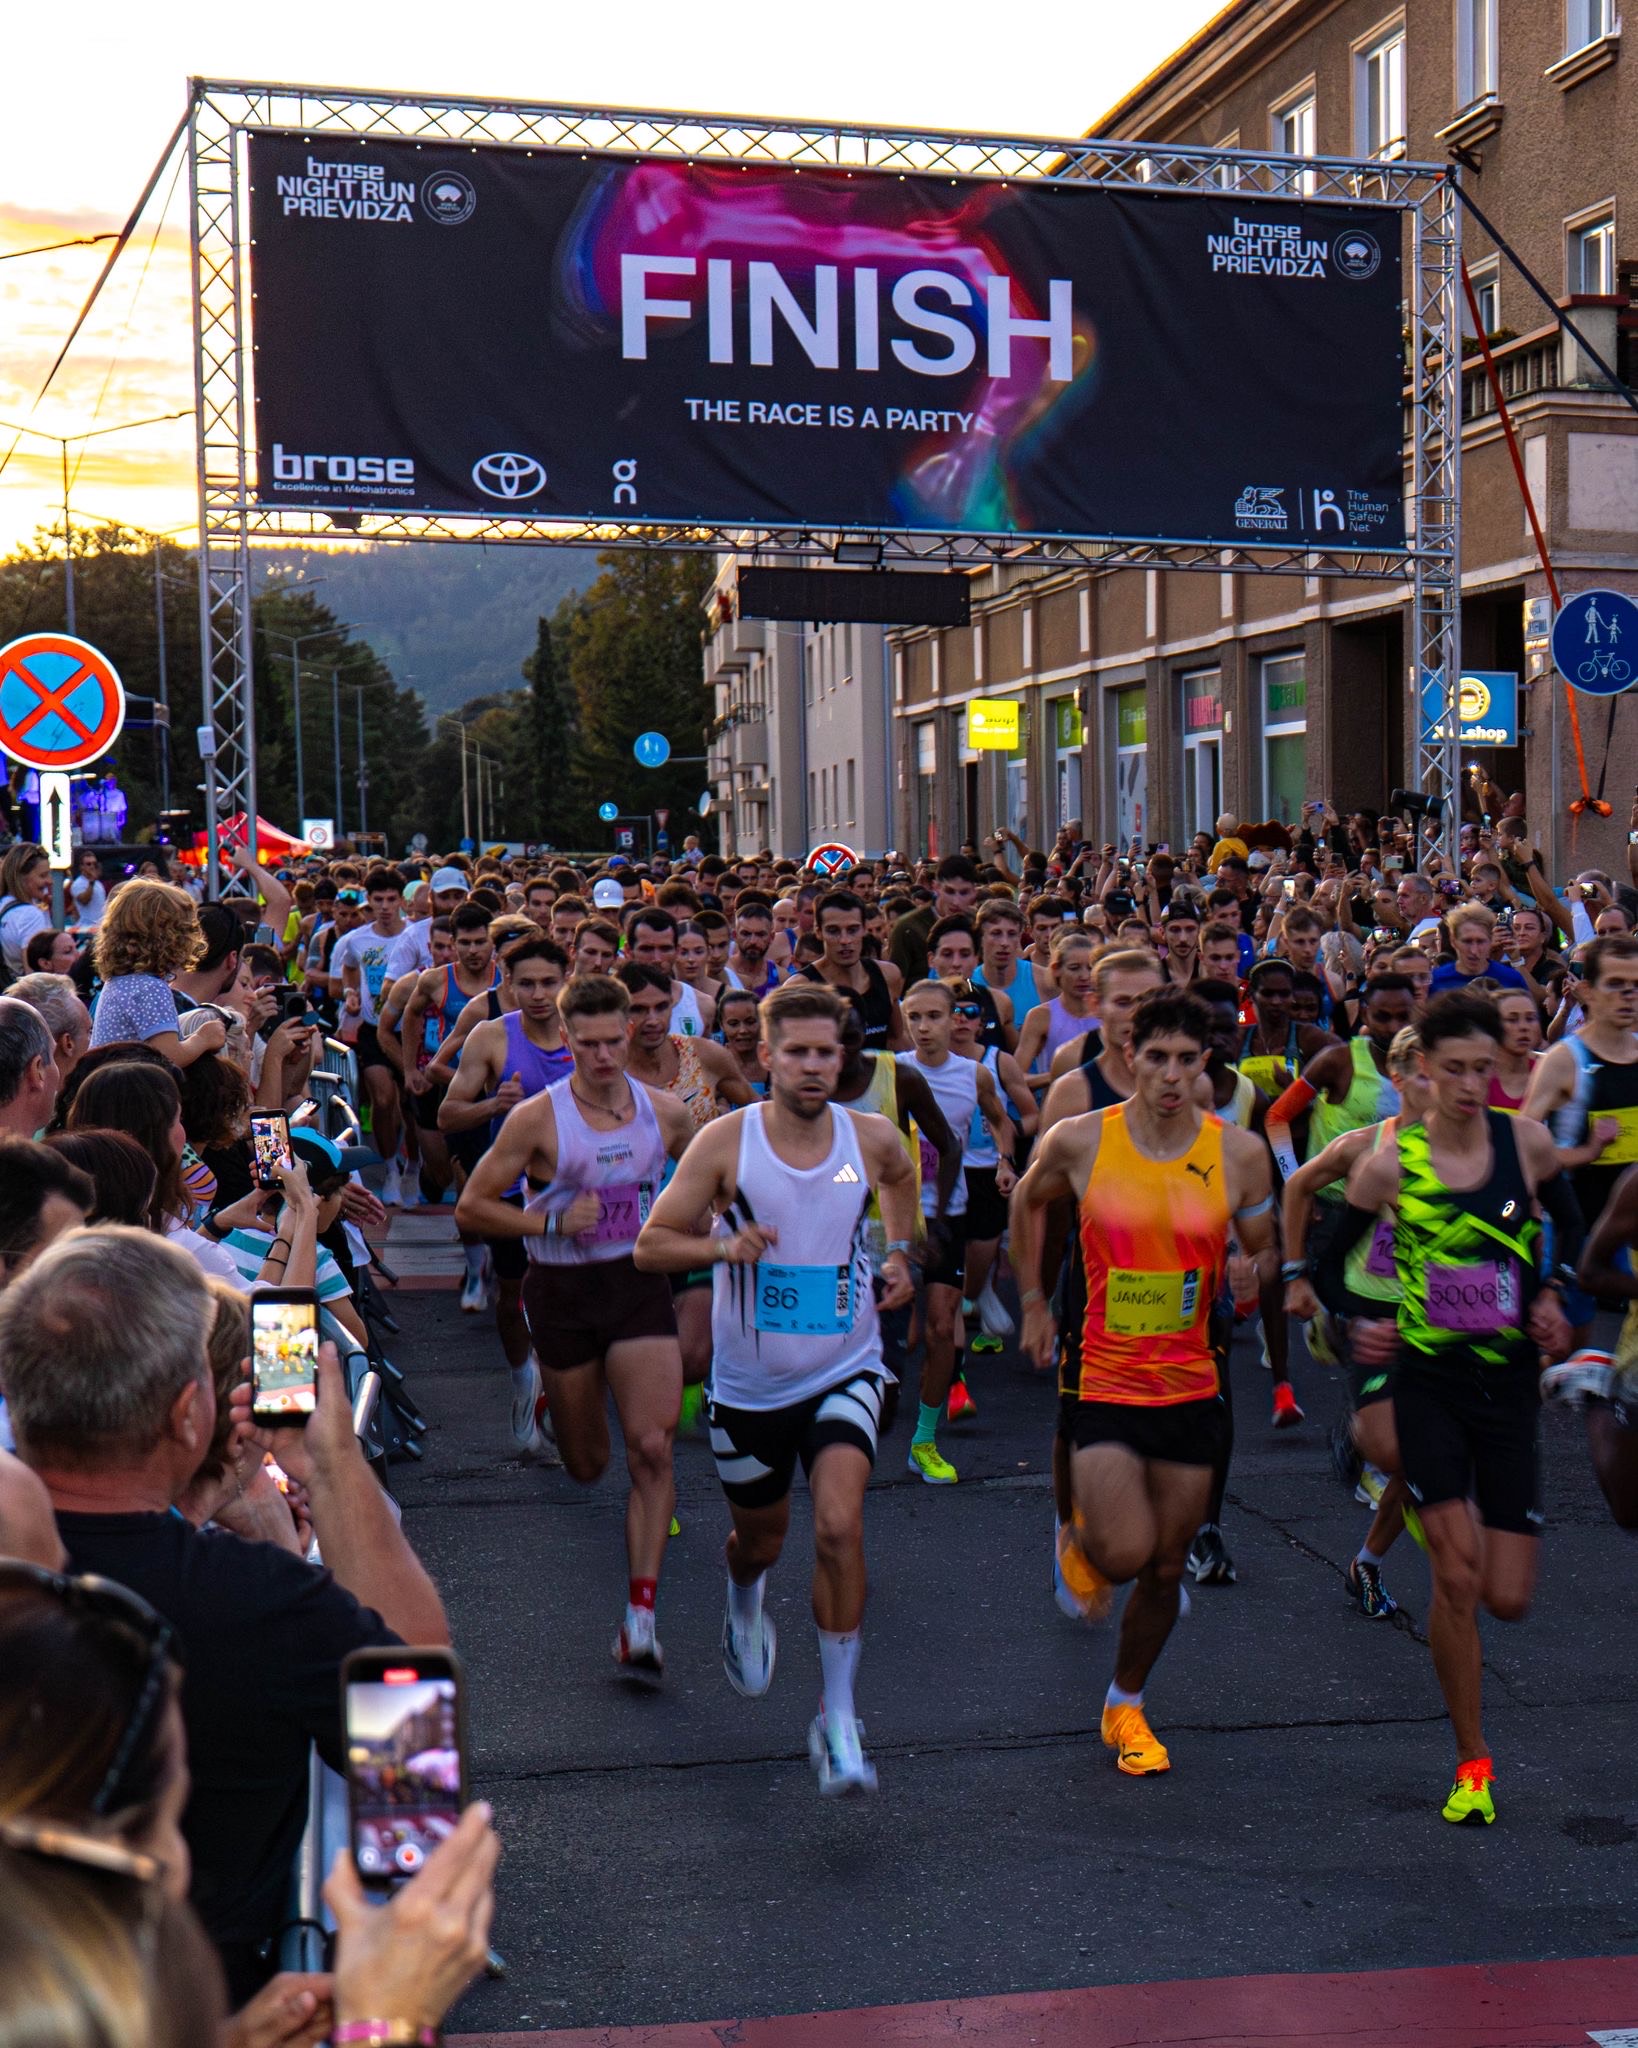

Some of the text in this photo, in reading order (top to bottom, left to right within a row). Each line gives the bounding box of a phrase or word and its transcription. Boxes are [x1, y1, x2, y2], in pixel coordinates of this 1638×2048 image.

[307, 156, 385, 180] brose
[277, 175, 415, 203] NIGHT RUN
[283, 196, 414, 223] PRIEVIDZA
[1234, 217, 1302, 240] brose
[1207, 234, 1328, 260] NIGHT RUN
[1213, 254, 1327, 279] PRIEVIDZA
[619, 252, 1074, 383] FINISH
[684, 398, 974, 433] THE RACE IS A PARTY
[272, 443, 415, 484] brose
[273, 481, 416, 496] Excellence in Mechatronics
[1347, 489, 1370, 501] The
[1348, 501, 1389, 513] Human
[1349, 512, 1386, 525] Safety
[1235, 518, 1289, 530] GENERALI
[1350, 522, 1371, 533] Net
[621, 831, 634, 845] B
[763, 1285, 800, 1310] 86
[1430, 1282, 1498, 1307] 5006
